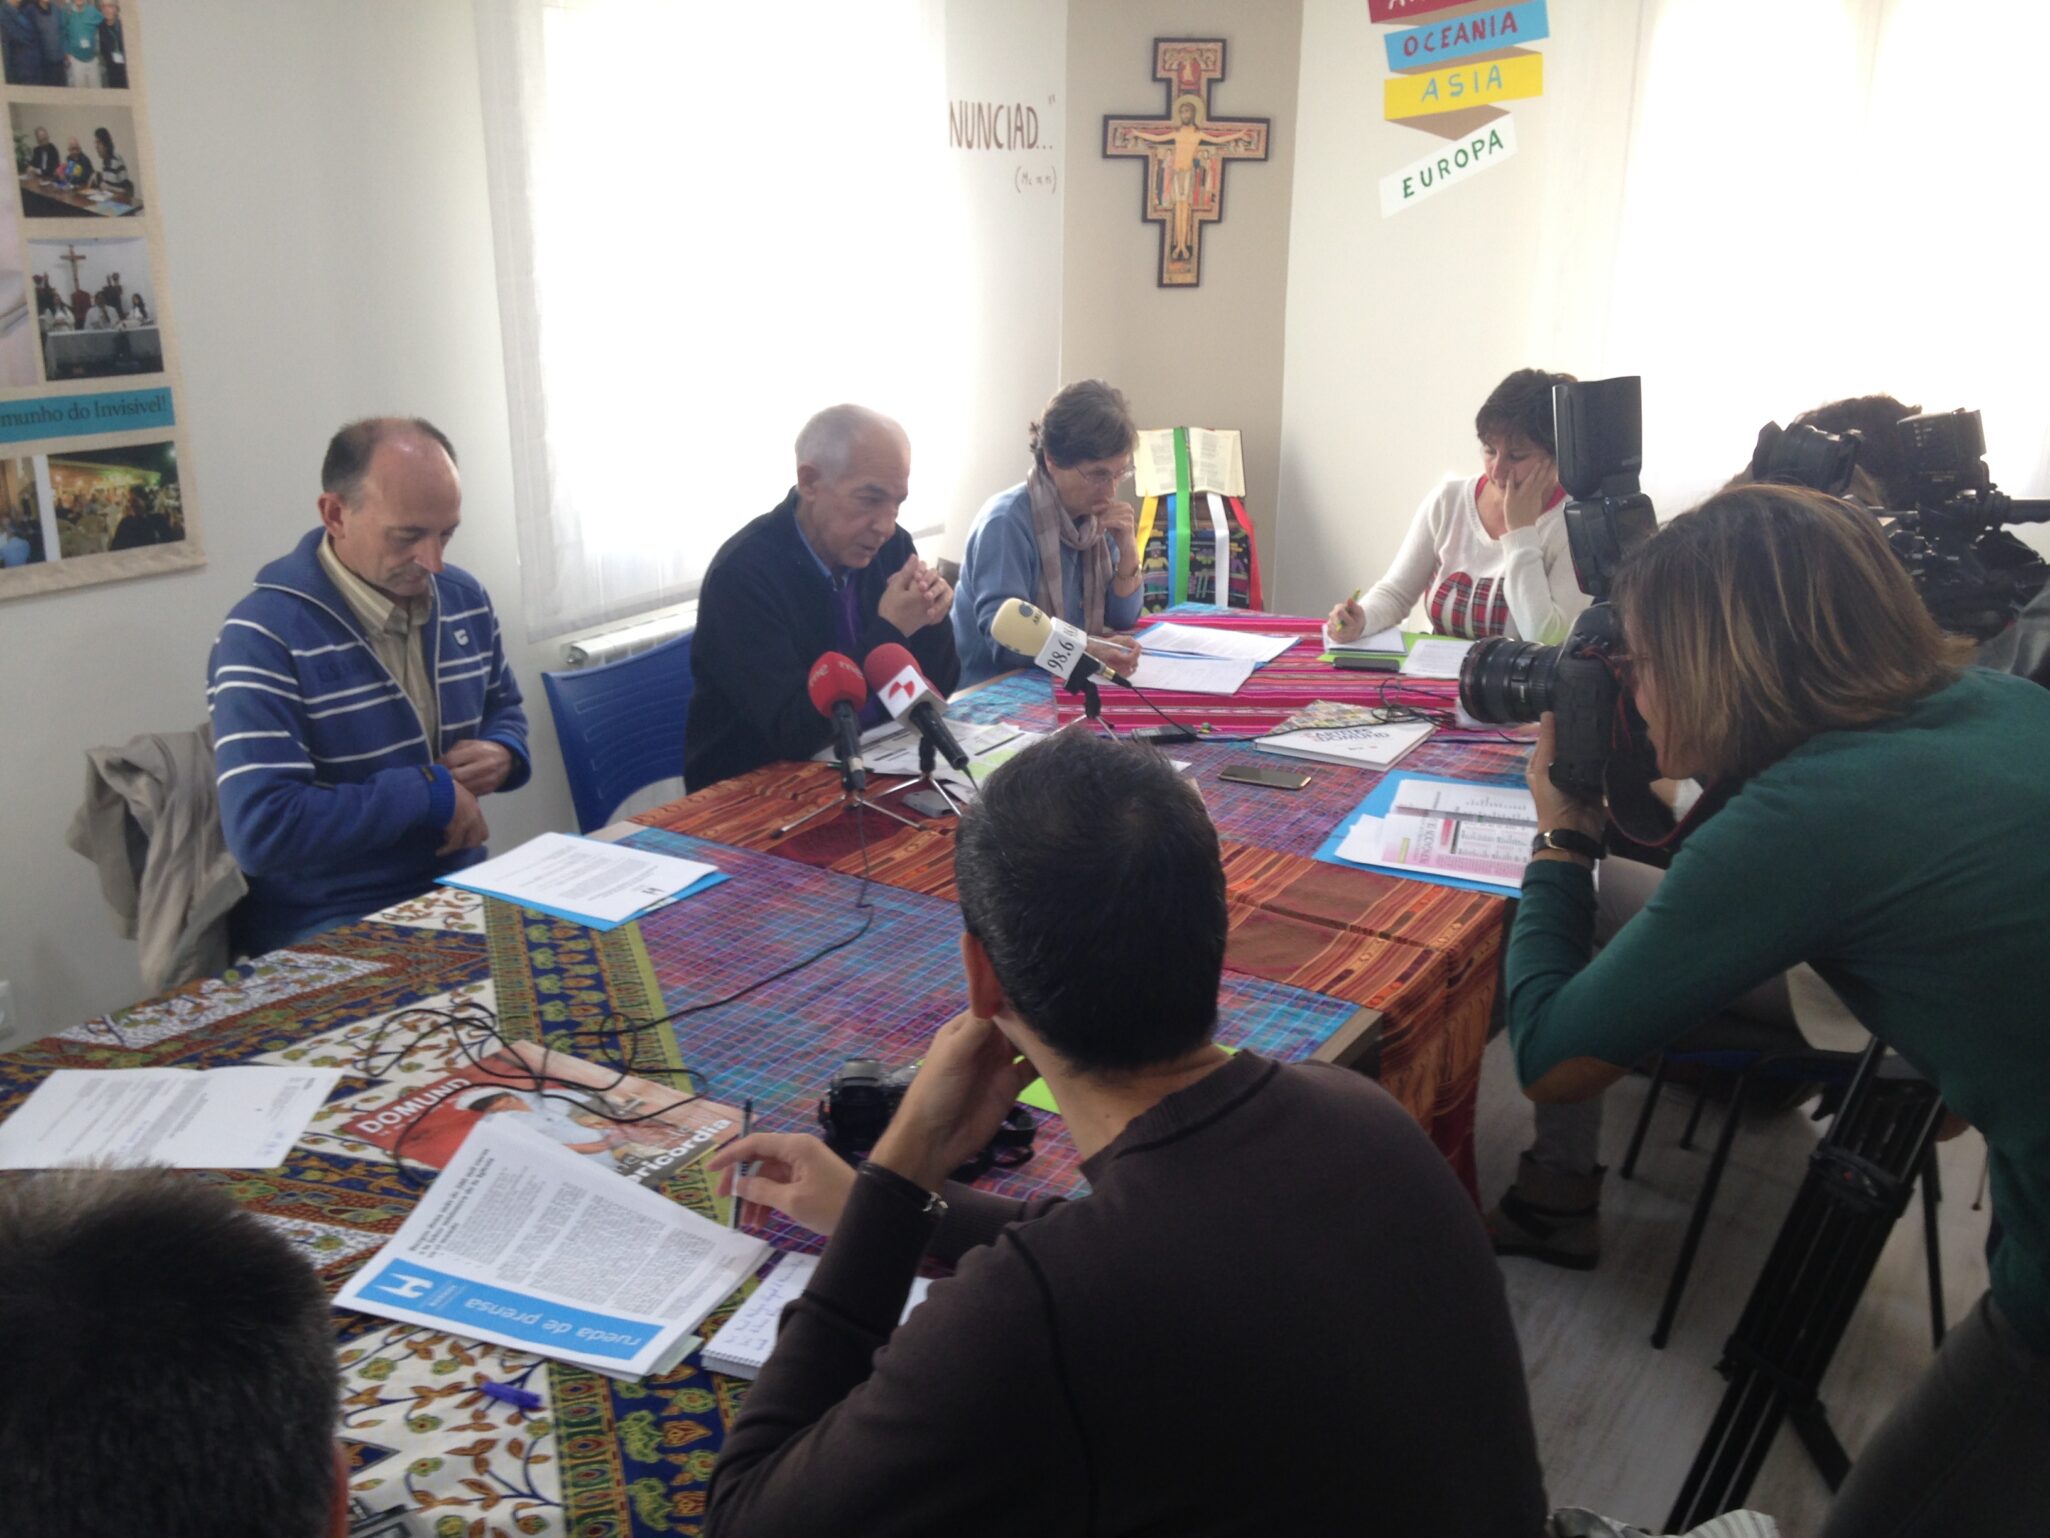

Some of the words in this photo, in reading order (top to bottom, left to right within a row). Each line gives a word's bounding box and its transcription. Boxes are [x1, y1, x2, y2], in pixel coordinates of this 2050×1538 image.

[1403, 11, 1518, 57] OCEANIA
[1420, 64, 1503, 103] ASIA
[1402, 129, 1504, 199] EUROPA
[68, 402, 91, 421] do
[1047, 639, 1075, 672] 98.6
[357, 1078, 472, 1133] DOMUND
[464, 1297, 544, 1326] prensa
[542, 1319, 573, 1335] de
[577, 1326, 643, 1347] rueda
